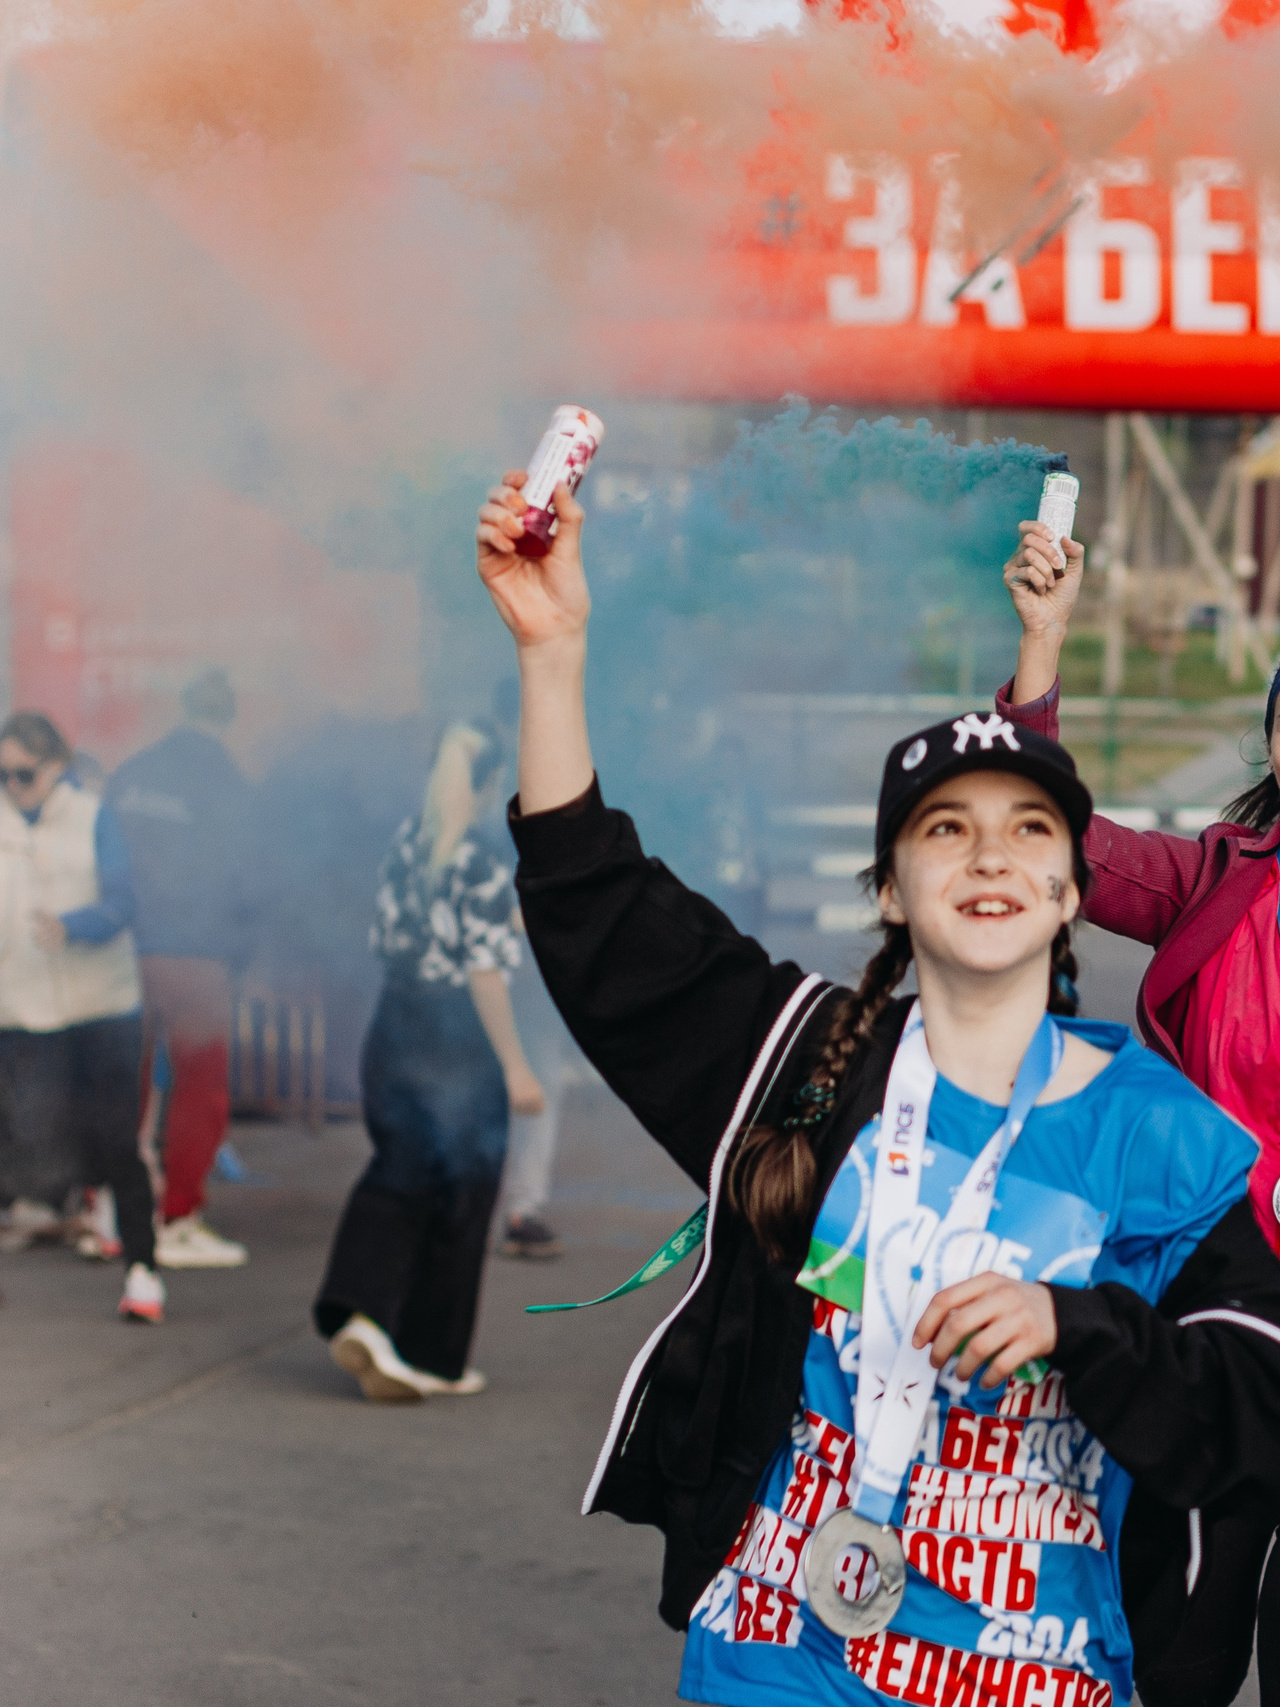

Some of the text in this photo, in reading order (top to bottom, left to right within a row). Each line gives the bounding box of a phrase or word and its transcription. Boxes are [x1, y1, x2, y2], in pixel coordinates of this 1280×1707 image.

[894, 1102, 915, 1146] ПСБ
[939, 1405, 1026, 1477] БЕГ
[734, 1575, 801, 1645] БЕГ
